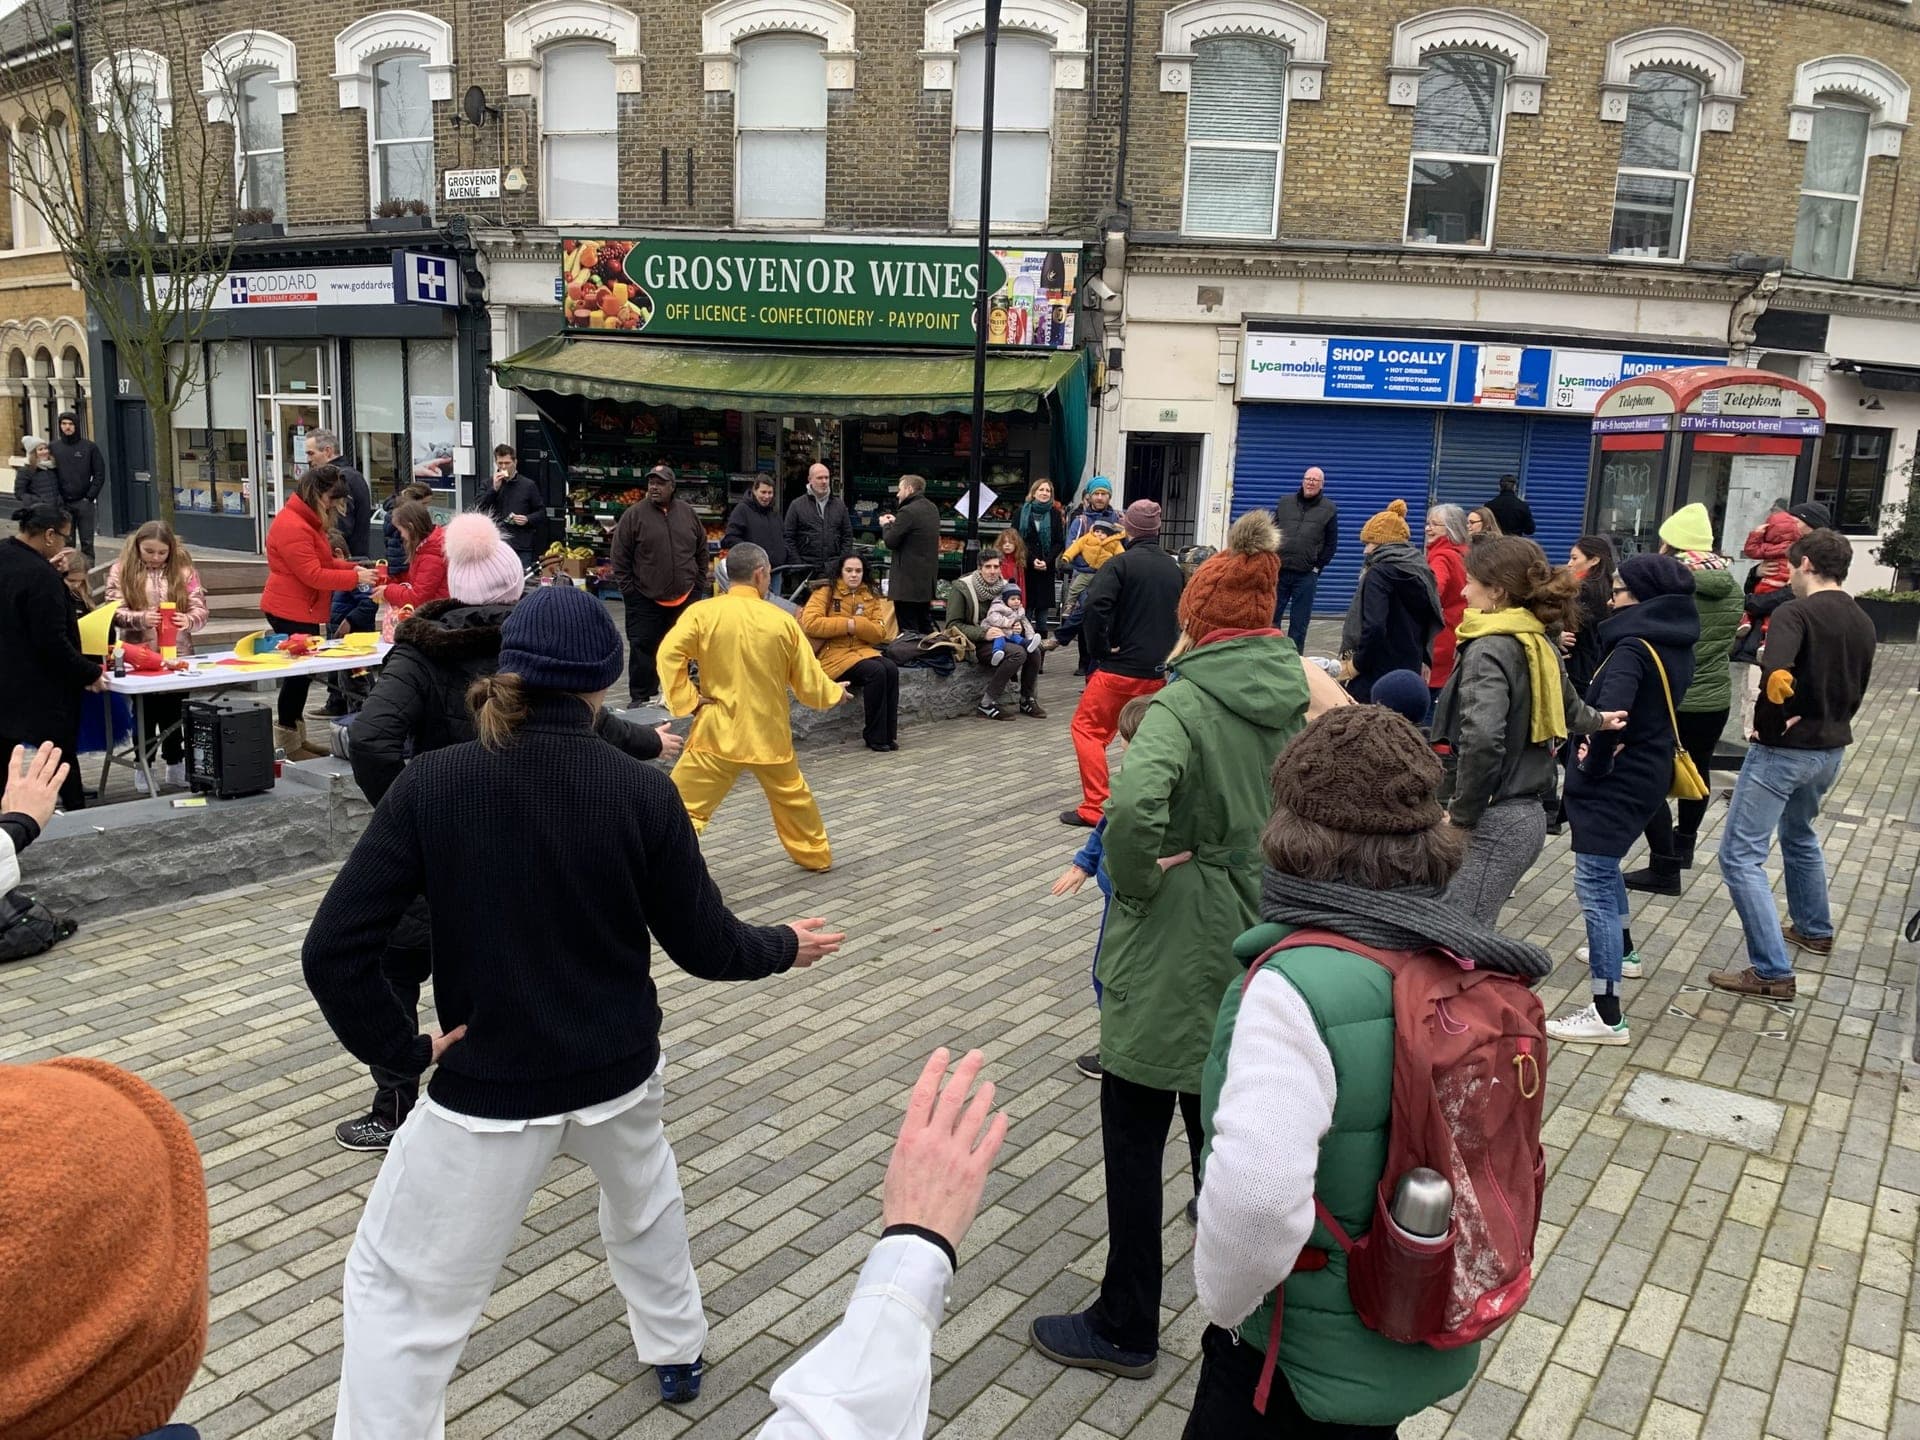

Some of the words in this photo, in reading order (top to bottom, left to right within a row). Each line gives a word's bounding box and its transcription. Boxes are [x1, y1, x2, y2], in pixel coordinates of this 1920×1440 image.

[448, 175, 497, 187] GROSVENOR
[449, 187, 481, 197] AVENUE
[247, 273, 317, 293] GODDARD
[644, 254, 857, 295] GROSVENOR
[868, 260, 979, 300] WINES
[256, 294, 287, 302] VETERINARY
[288, 293, 309, 301] GROUP
[665, 303, 690, 321] OFF
[694, 305, 747, 323] LICENCE
[759, 307, 875, 327] CONFECTIONERY
[888, 311, 960, 331] PAYPOINT
[1331, 347, 1376, 362] SHOP
[1378, 349, 1447, 365] LOCALLY
[1251, 359, 1326, 373] Lycamobile
[119, 379, 130, 394] 87
[1336, 382, 1375, 390] STATIONERY
[1389, 376, 1440, 384] CONFECTIONERY
[1388, 384, 1420, 392] GREETING
[1561, 391, 1570, 402] 91
[1618, 394, 1655, 409] Telephone
[1723, 392, 1782, 409] Telephon
[1614, 420, 1635, 430] hotspot
[1681, 417, 1692, 428] BT
[1694, 418, 1718, 428] Wi-fi
[1720, 419, 1756, 431] hotspot
[1758, 420, 1782, 431] here!
[1802, 423, 1820, 434] wifi
